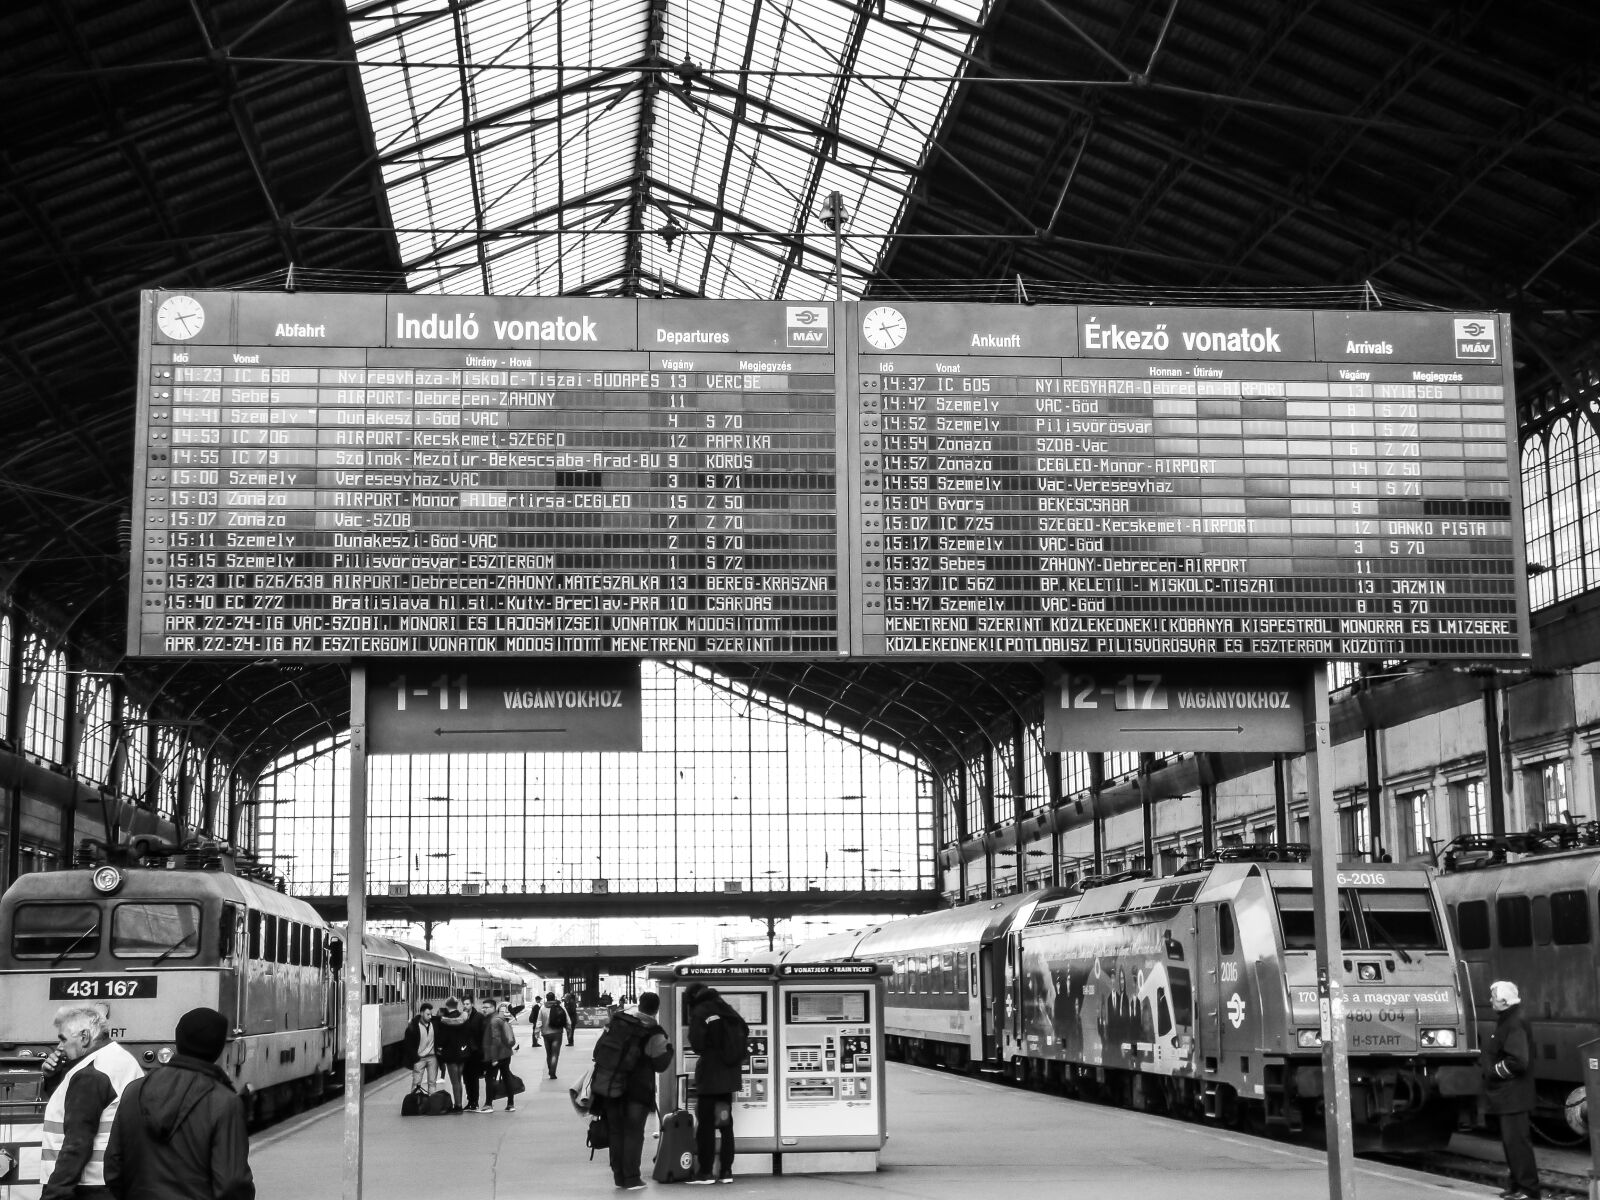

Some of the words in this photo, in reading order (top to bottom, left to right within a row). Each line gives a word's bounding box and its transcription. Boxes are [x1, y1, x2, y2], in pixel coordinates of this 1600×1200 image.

[275, 324, 325, 338] Abfahrt
[397, 312, 479, 340] Induló
[493, 316, 598, 342] vonatok
[793, 330, 823, 341] MÁV
[1085, 317, 1169, 350] Érkező
[1182, 328, 1281, 352] vonatok
[656, 328, 729, 344] Departures
[971, 334, 1021, 348] Ankunft
[1346, 340, 1393, 355] Arrivals
[1462, 344, 1490, 353] MÁV
[173, 353, 188, 363] Idő
[233, 354, 259, 363] Vonat
[466, 356, 498, 368] Útirány
[510, 358, 532, 366] Hová
[662, 360, 694, 371] Vágány
[740, 361, 792, 372] Megjegyzés
[234, 369, 251, 383] IC
[261, 369, 290, 383] 658
[670, 376, 687, 388] 13
[706, 376, 760, 389] VERCSE
[880, 362, 894, 372] Idő
[936, 364, 960, 372] Vonat
[1150, 367, 1182, 376] Honnan
[1193, 365, 1223, 379] Útirány
[1339, 370, 1370, 381] Vágány
[1412, 370, 1462, 382] Megjegyzés
[883, 377, 926, 392] 14:37
[938, 378, 954, 392] IC
[963, 379, 990, 393] 605
[231, 388, 280, 403] Sebes
[670, 394, 684, 408] 11
[883, 396, 926, 411] 14:47
[668, 414, 678, 428] 4
[706, 415, 715, 428] S
[724, 415, 743, 428] 70
[884, 417, 927, 431] 14:52
[232, 430, 250, 444] IC
[259, 430, 288, 444] 706
[670, 435, 687, 448] 12
[706, 435, 771, 449] PAPRIKA
[884, 436, 927, 451] 14:54
[173, 449, 220, 464] 14:55
[231, 450, 249, 464] IC
[258, 450, 278, 465] 79
[668, 455, 678, 468] 9
[884, 456, 927, 470] 14:57
[172, 470, 219, 485] 15:00
[668, 474, 678, 488] 3
[706, 475, 715, 488] S
[725, 475, 741, 488] 71
[885, 476, 928, 490] 14:59
[1404, 482, 1421, 496] 71
[170, 491, 218, 505] 15:03
[670, 495, 687, 509] 15
[707, 496, 715, 509] Z
[724, 496, 743, 509] 50
[885, 496, 928, 510] 15:04
[938, 497, 984, 511] Gyors
[170, 511, 217, 526] 15:07
[668, 516, 677, 529] 7
[707, 516, 715, 529] Z
[725, 516, 743, 530] 70
[885, 517, 928, 531] 15:07
[940, 517, 957, 531] IC
[965, 517, 993, 531] 725
[1354, 521, 1371, 535] 12
[1442, 521, 1486, 536] PISTA
[170, 532, 215, 547] 15:11
[668, 536, 678, 549] 2
[706, 536, 715, 550] S
[725, 536, 743, 550] 70
[885, 537, 929, 551] 15:17
[1354, 540, 1363, 554] 3
[1390, 541, 1399, 554] S
[1408, 541, 1425, 554] 70
[169, 554, 216, 568] 15:15
[706, 557, 715, 570] S
[725, 557, 743, 570] 72
[886, 557, 930, 570] 15:32
[940, 557, 986, 571] Sebes
[1357, 560, 1371, 574] 11
[169, 574, 215, 589] 15:23
[228, 575, 245, 589] IC
[255, 575, 324, 589] 626/638
[670, 576, 687, 590] 13
[706, 576, 828, 591] BEREG-KRASZNA
[886, 577, 930, 590] 15:37
[941, 577, 958, 591] IC
[967, 577, 995, 591] 562
[1041, 578, 1122, 592] BP.KELETI
[1150, 579, 1274, 593] MISKOLC-TISZAI
[1357, 580, 1374, 594] 13
[167, 595, 214, 609] 15:40
[225, 595, 244, 609] EC
[254, 596, 284, 610] 272
[332, 596, 430, 610] Bratislava
[670, 597, 687, 611] 10
[886, 597, 930, 611] 15:47
[1357, 600, 1366, 613] 8
[1393, 600, 1402, 614] S
[1410, 600, 1428, 614] 70
[166, 616, 283, 630] APR.22-24-IG
[400, 617, 456, 630] MONORI
[612, 617, 678, 631] VONATOK
[886, 617, 968, 632] MENETREND
[978, 618, 1041, 632] SZERINT
[1341, 620, 1404, 634] MONORRA
[166, 637, 283, 651] APR.22-24-IG
[293, 637, 312, 651] AZ
[322, 637, 418, 651] ESZTERGOMI
[429, 637, 496, 651] VONATOK
[612, 637, 696, 651] MENETREND
[707, 637, 772, 652] SZERINT
[1252, 639, 1332, 653] ESZTERGOM
[390, 674, 468, 710] 1-11
[503, 688, 622, 709] VÁGÁNYOKHOZ
[1054, 674, 1162, 709] 12-17
[1177, 688, 1290, 709] VÁGÁNYOKHOZ
[1221, 962, 1238, 982] 2016
[67, 981, 99, 997] 431
[106, 980, 138, 996] 167
[1298, 992, 1317, 1003] 170
[1365, 993, 1410, 1005] magyar
[1414, 990, 1449, 1002] vasút!
[1347, 1009, 1372, 1022] 480
[1378, 1009, 1404, 1022] 004
[1353, 1035, 1400, 1046] H-START
